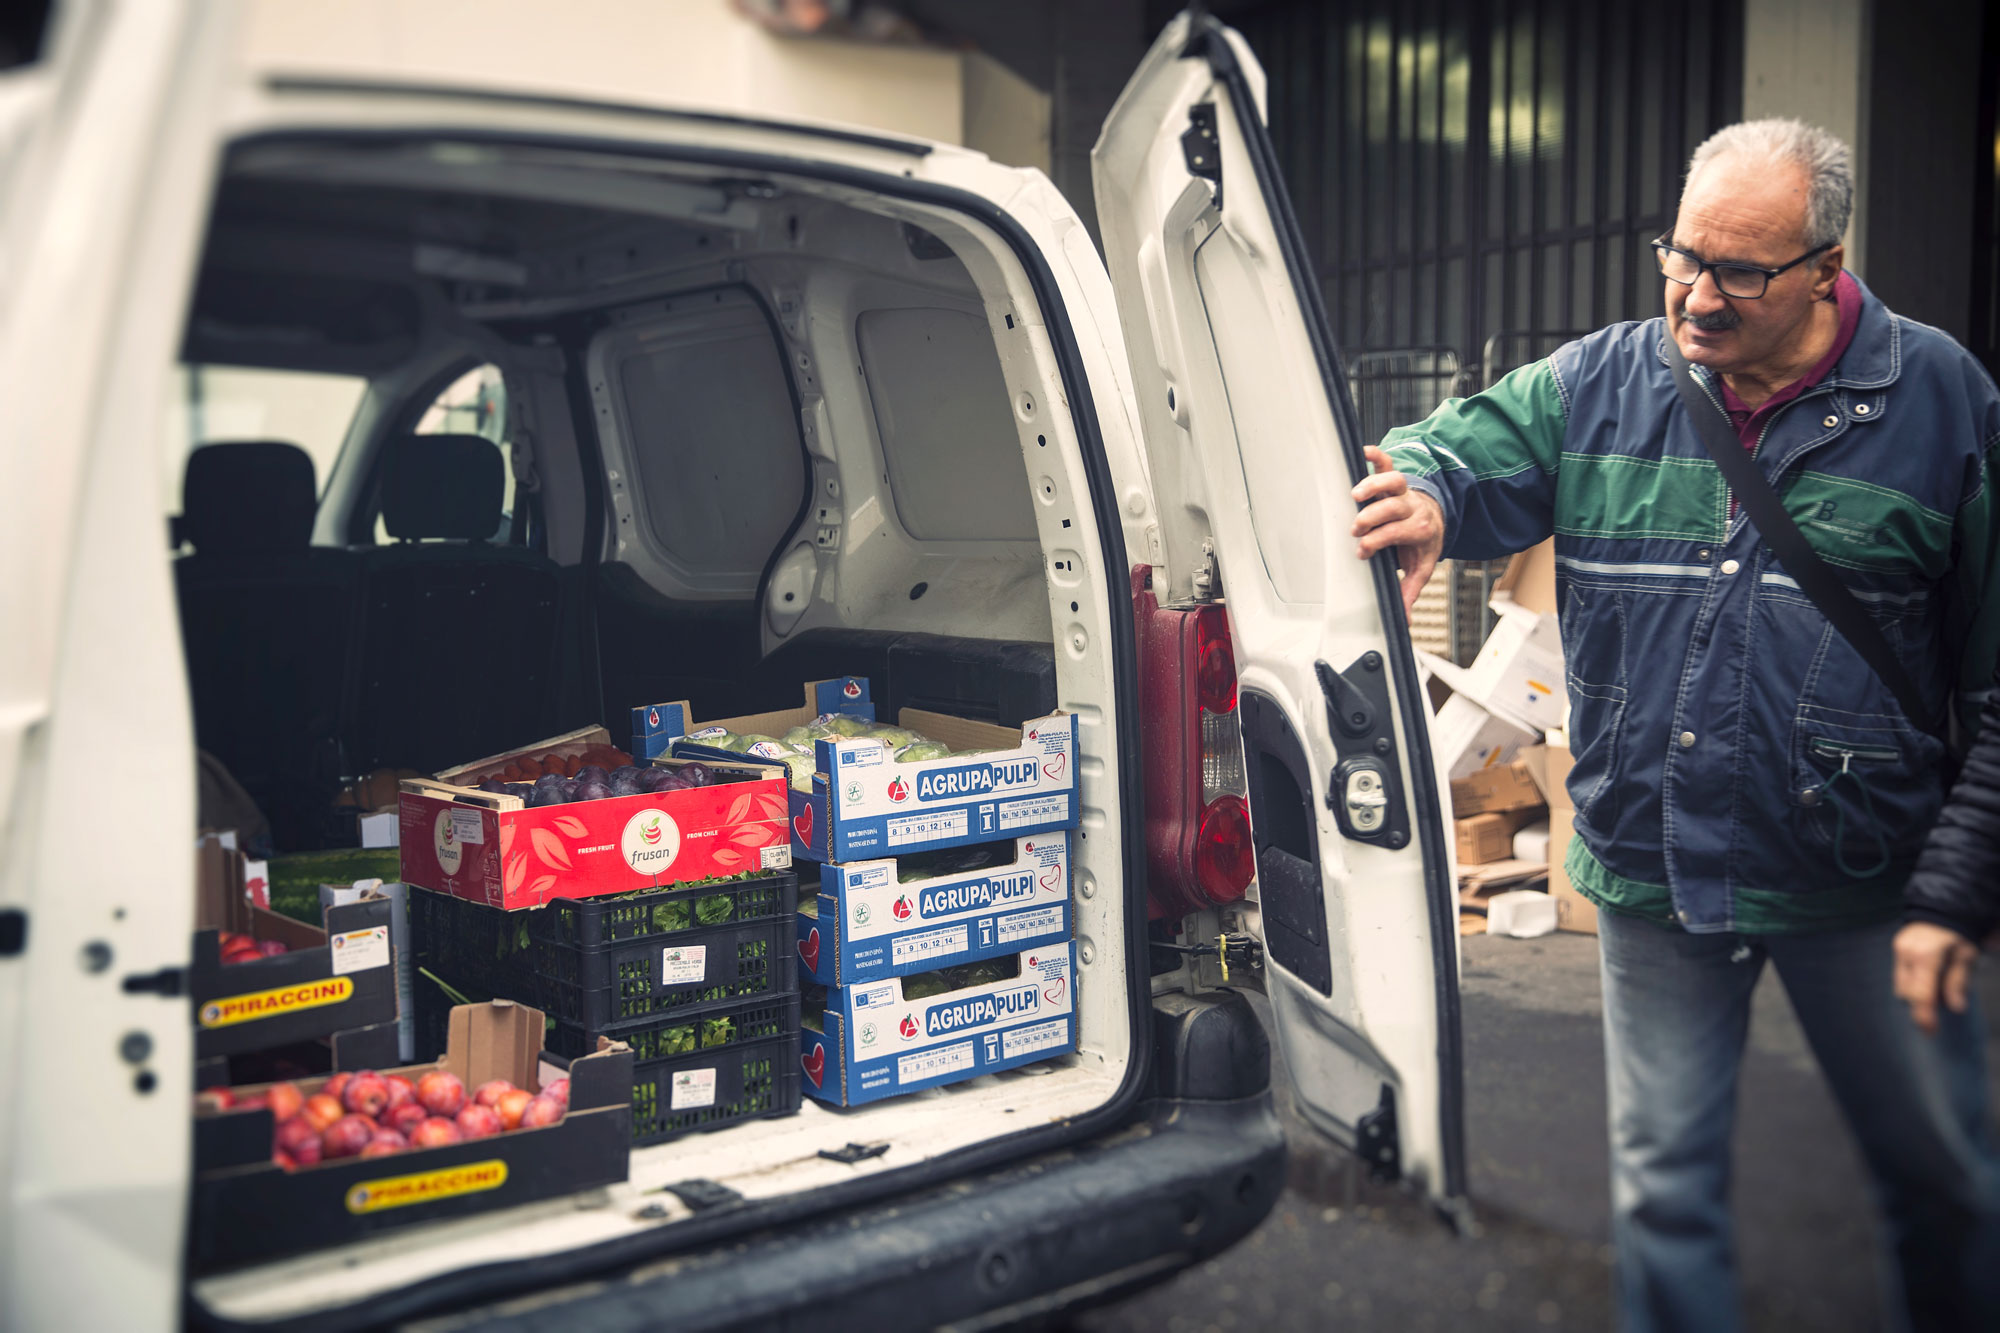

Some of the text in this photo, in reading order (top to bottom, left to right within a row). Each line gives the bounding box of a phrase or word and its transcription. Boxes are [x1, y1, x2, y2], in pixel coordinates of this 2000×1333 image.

[919, 762, 1038, 797] AGRUPAPULPI
[686, 829, 719, 840] FROM CHILE
[892, 820, 952, 836] 8 9 10 12 14
[577, 843, 616, 855] FRESH FRUIT
[631, 848, 670, 866] frusan
[922, 875, 1033, 915] AGRUPAPULPI
[896, 937, 953, 955] 8 9 10 12 14
[223, 982, 345, 1018] PIRACCINI
[928, 989, 1038, 1033] AGRUPAPULPI
[903, 1066, 908, 1074] 8
[951, 1053, 959, 1061] 14
